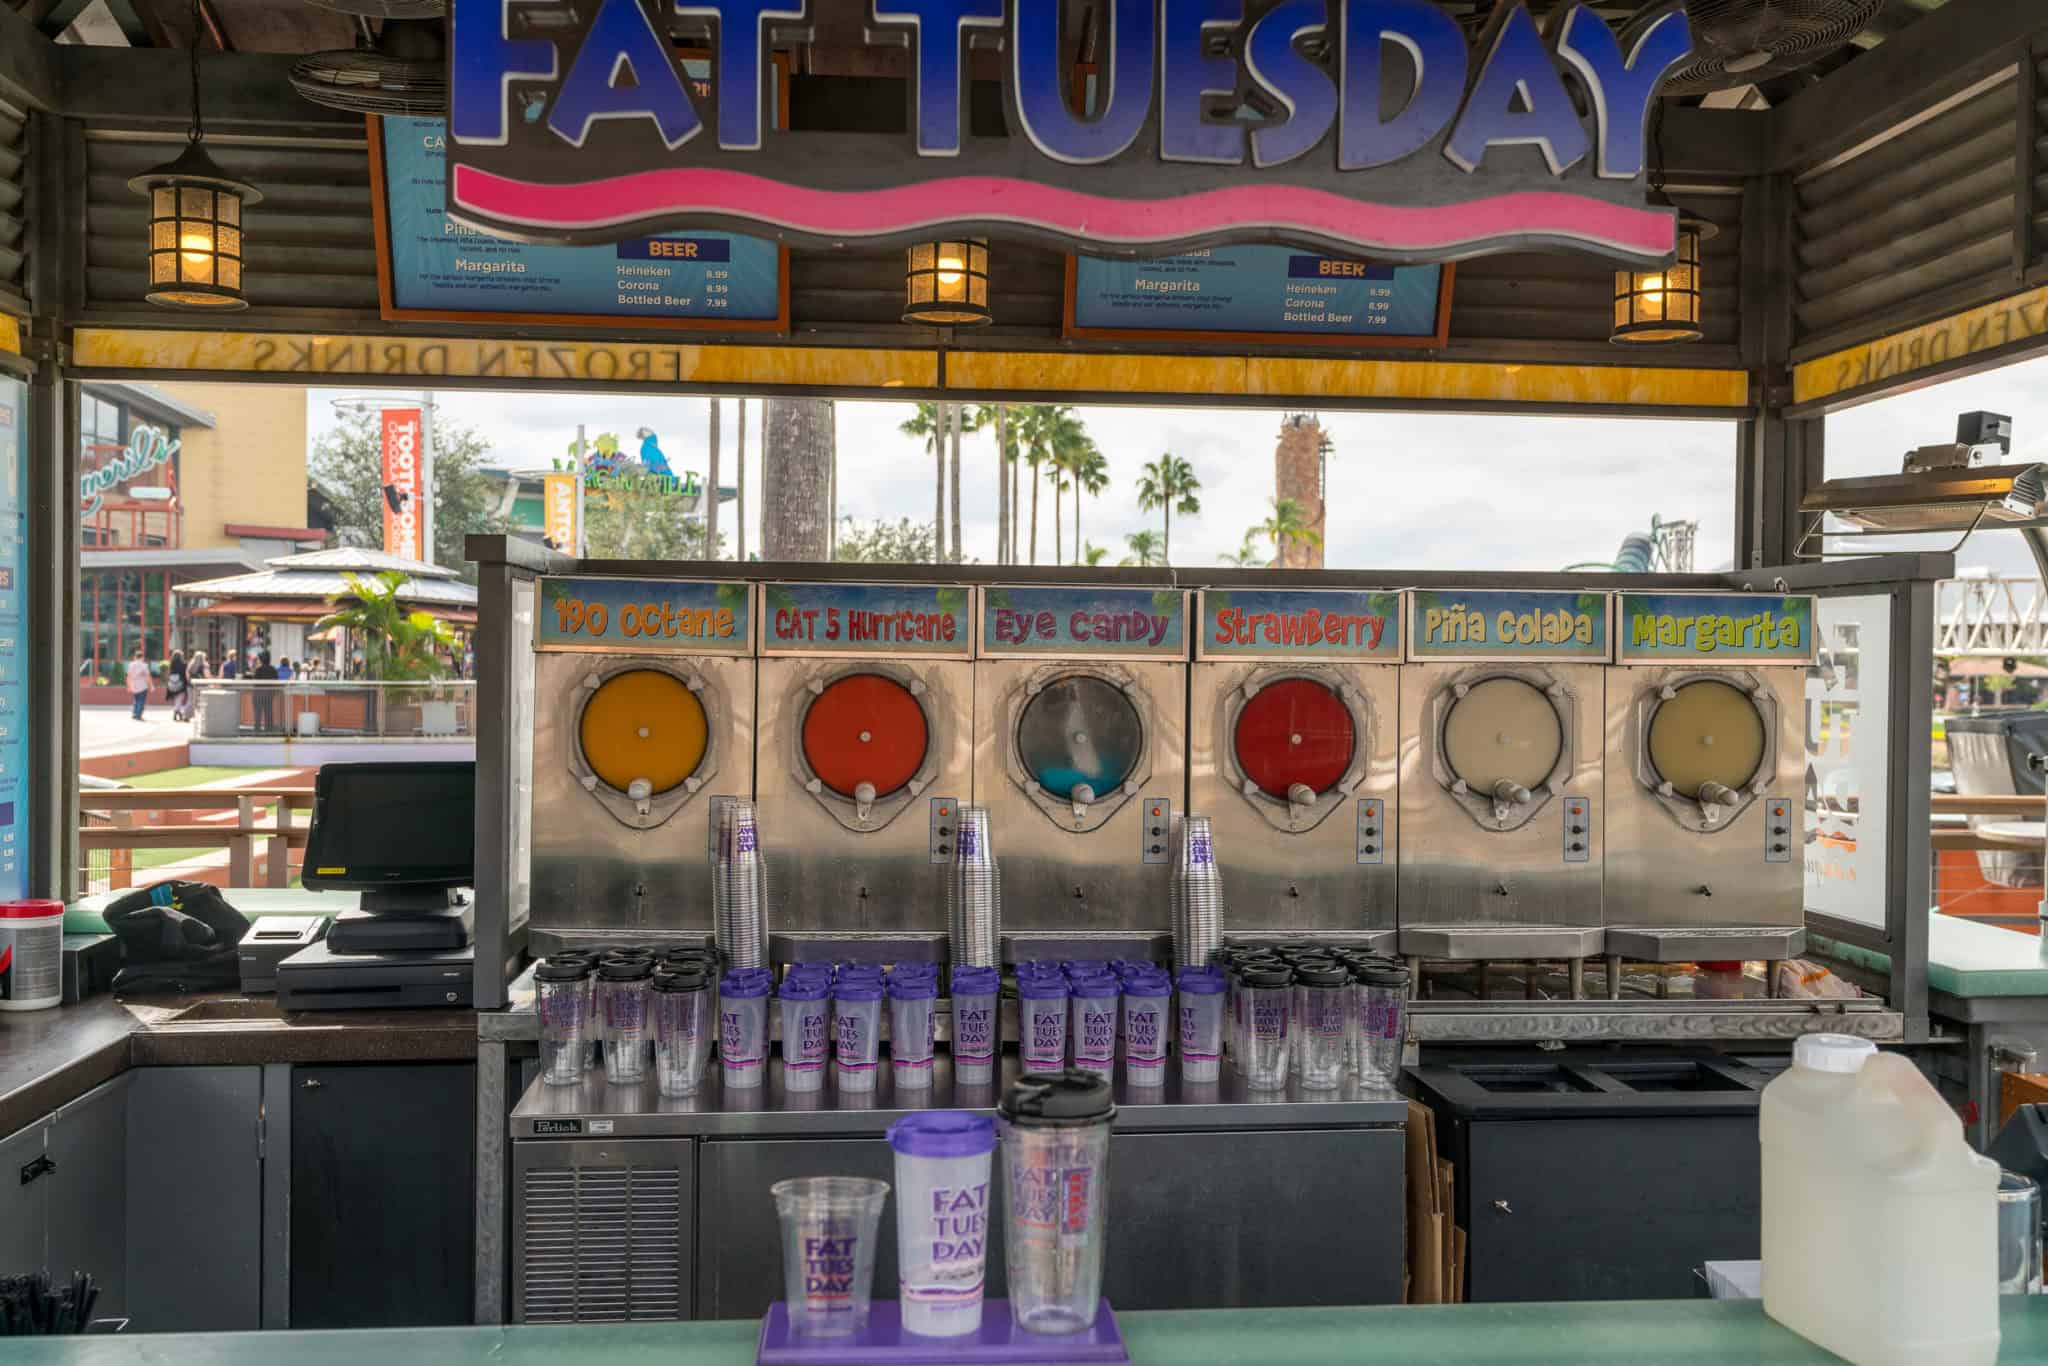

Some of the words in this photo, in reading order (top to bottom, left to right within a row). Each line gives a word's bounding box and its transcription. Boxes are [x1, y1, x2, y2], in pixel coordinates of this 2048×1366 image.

[451, 0, 804, 151] FAT
[873, 0, 1693, 179] TUESDAY
[423, 136, 446, 149] CA
[649, 241, 698, 257] BEER
[455, 259, 527, 274] Margarita
[616, 265, 670, 277] Heineken
[1319, 260, 1366, 277] BEER
[617, 280, 660, 290] Corona
[1135, 279, 1200, 292] Margarita
[1286, 284, 1337, 295] Heineken
[618, 294, 661, 305] Bottled
[664, 296, 691, 306] Beer
[1285, 298, 1325, 308] Corona
[1284, 311, 1325, 322] Bottled
[1328, 313, 1352, 323] Beer
[1367, 315, 1387, 324] 7.99
[80, 424, 181, 510] meril's
[552, 598, 609, 637] 190
[775, 607, 818, 641] CAT
[825, 607, 841, 641] 5
[1425, 603, 1487, 644] Piña
[994, 607, 1058, 645] Eye
[1632, 612, 1801, 652] Margarita
[960, 1009, 991, 1021] FAT
[1034, 1013, 1064, 1025] FAT
[1085, 1012, 1114, 1024] FAT
[1128, 1010, 1160, 1023] FAT
[961, 1022, 990, 1033] TUES
[1034, 1026, 1063, 1037] TUES
[1086, 1025, 1113, 1036] TUES
[1129, 1023, 1157, 1035] TUES
[960, 1033, 989, 1043] DAY
[1034, 1037, 1061, 1048] DAY
[1085, 1036, 1111, 1048] DAY
[1128, 1034, 1154, 1046] DAY
[932, 1183, 988, 1213] FAT
[804, 1237, 858, 1257] FAT
[932, 1239, 984, 1262] DAY
[806, 1259, 855, 1275] TUES
[805, 1277, 855, 1293] DAY
